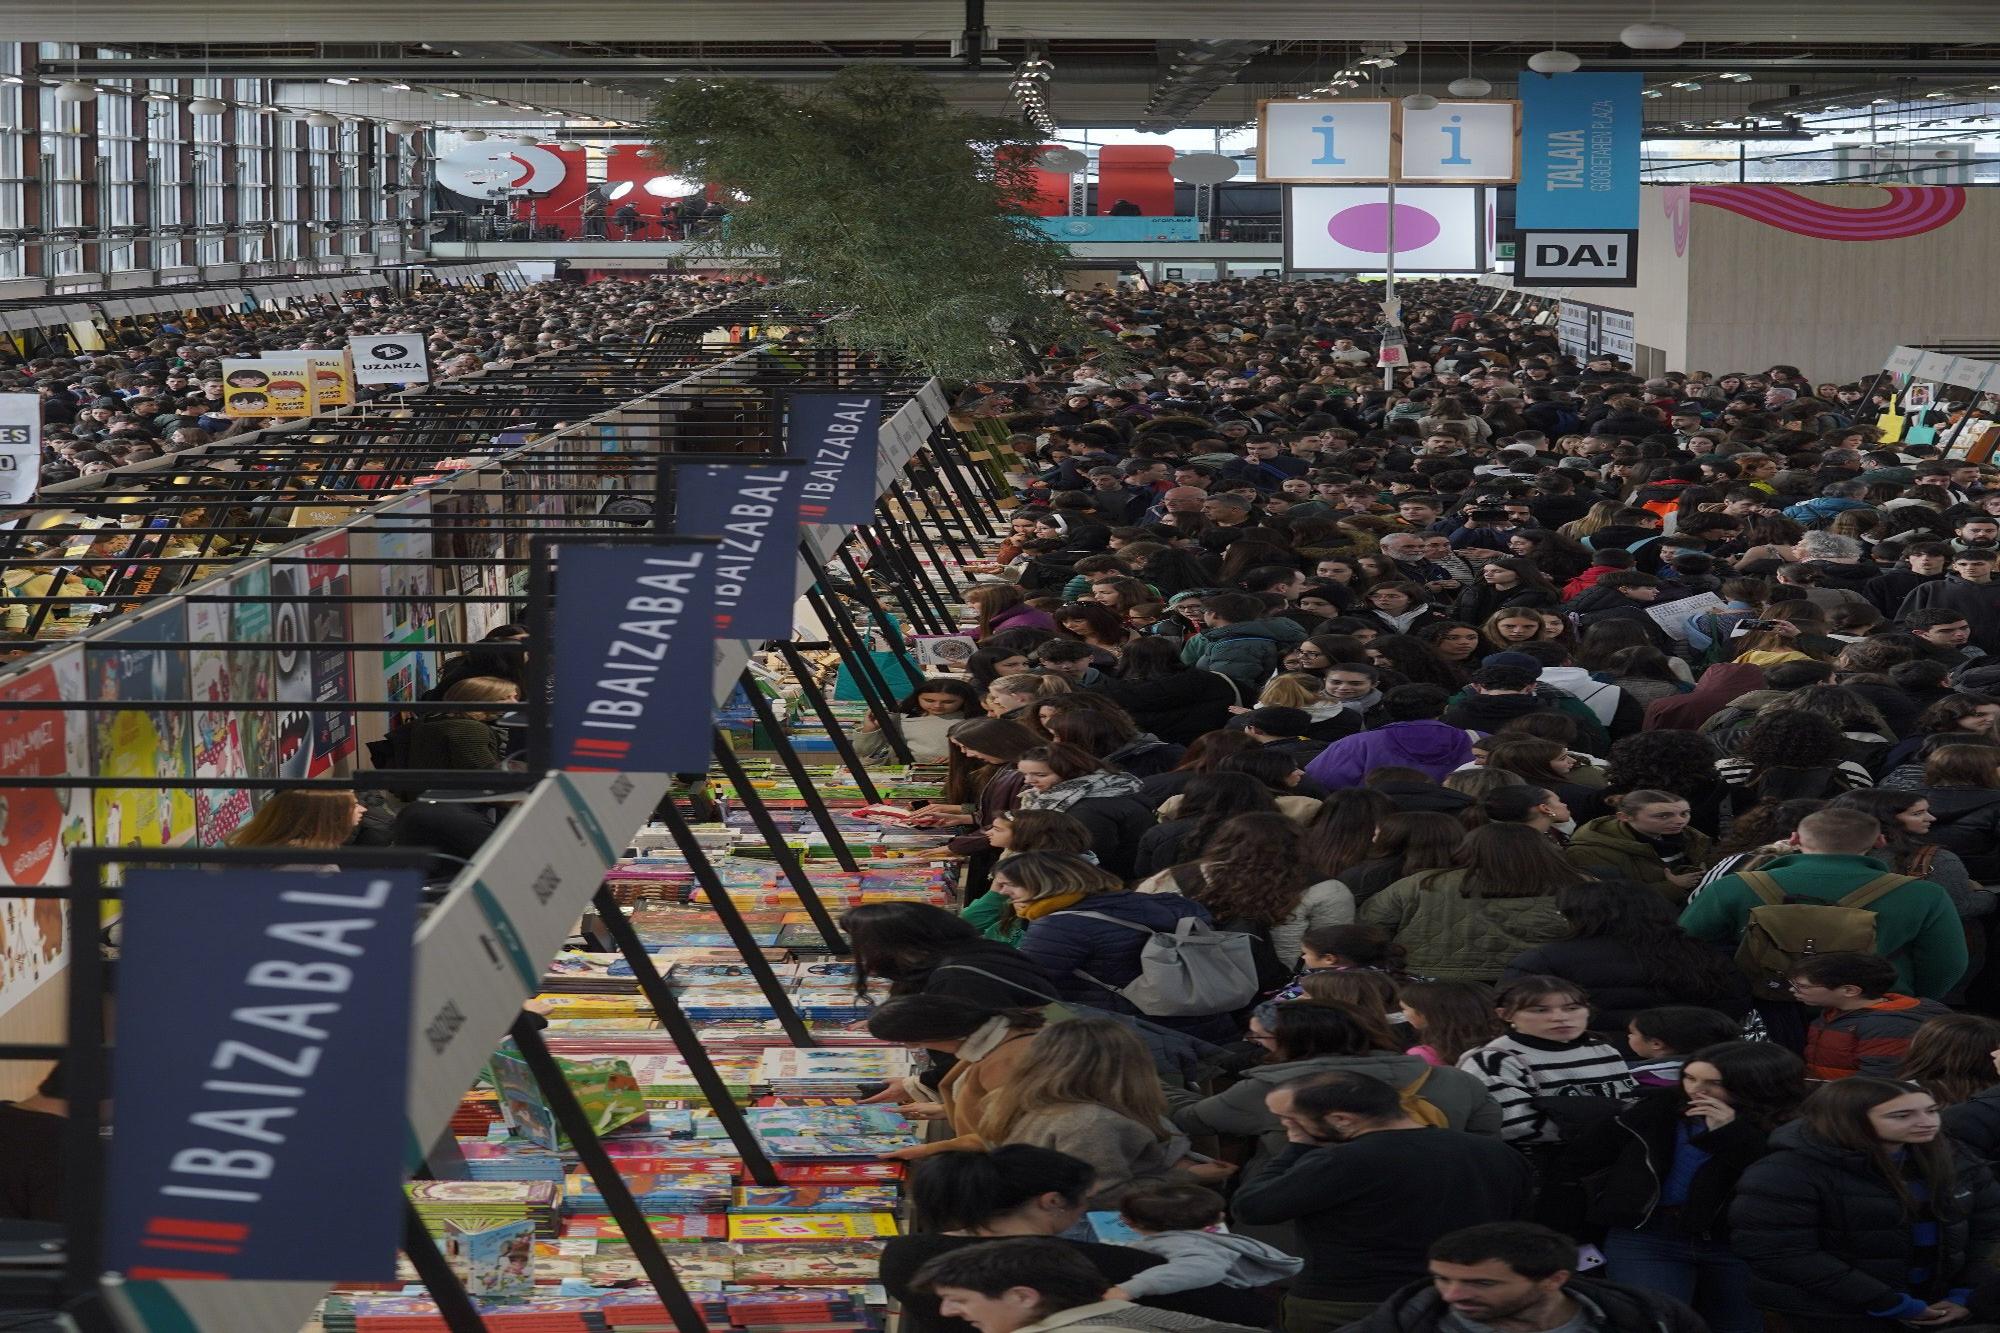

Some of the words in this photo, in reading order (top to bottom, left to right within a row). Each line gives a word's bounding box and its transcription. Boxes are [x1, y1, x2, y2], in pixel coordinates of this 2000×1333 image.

[1591, 100, 1614, 129] PLAZA
[1547, 129, 1585, 192] TALAIA
[1590, 131, 1612, 192] GOGOETAREN
[1535, 244, 1618, 267] DA!
[362, 361, 422, 371] UZANZA
[800, 398, 871, 500] IBAIZABAL
[581, 551, 704, 730] IBAIZABAL
[159, 879, 394, 1203] IBAIZABAL
